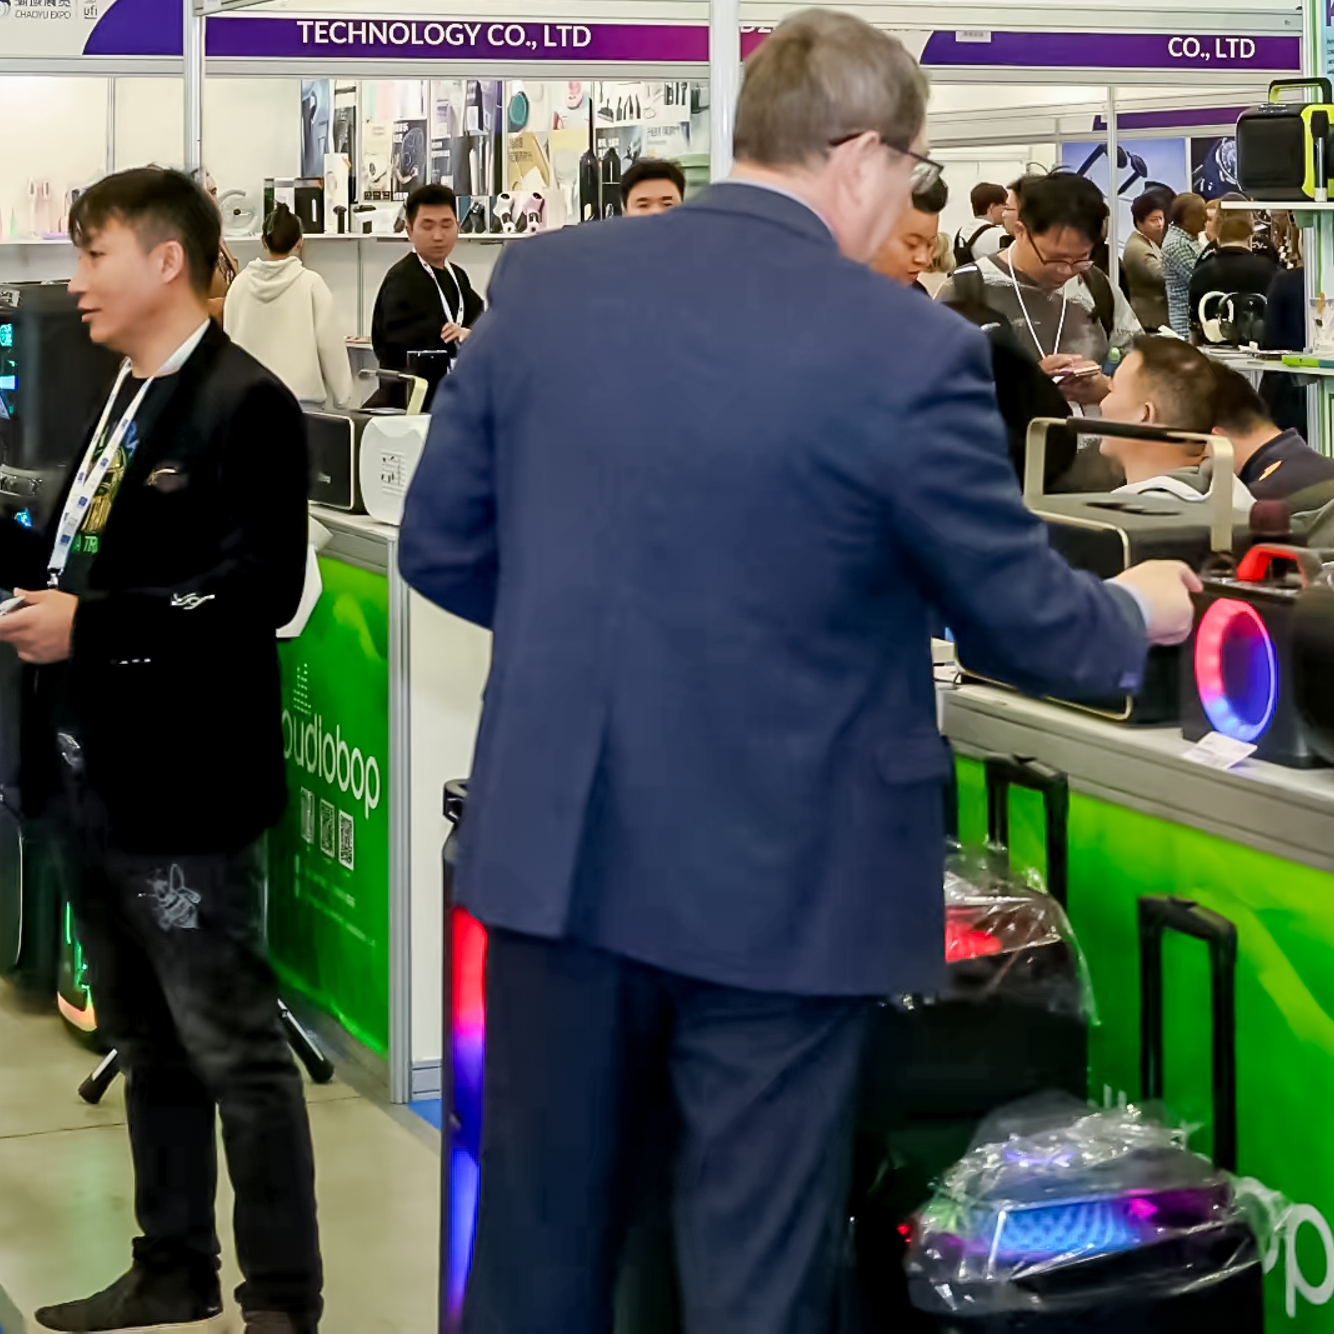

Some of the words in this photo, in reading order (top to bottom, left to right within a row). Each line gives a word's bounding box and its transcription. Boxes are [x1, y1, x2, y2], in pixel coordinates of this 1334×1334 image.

[15, 10, 48, 20] CHAOYU
[50, 10, 72, 20] EXPO
[296, 19, 481, 47] TECHNOLOGY
[487, 23, 538, 49] CO.,
[543, 24, 592, 48] LTD
[1167, 37, 1211, 60] CO.,
[1215, 37, 1256, 58] LTD
